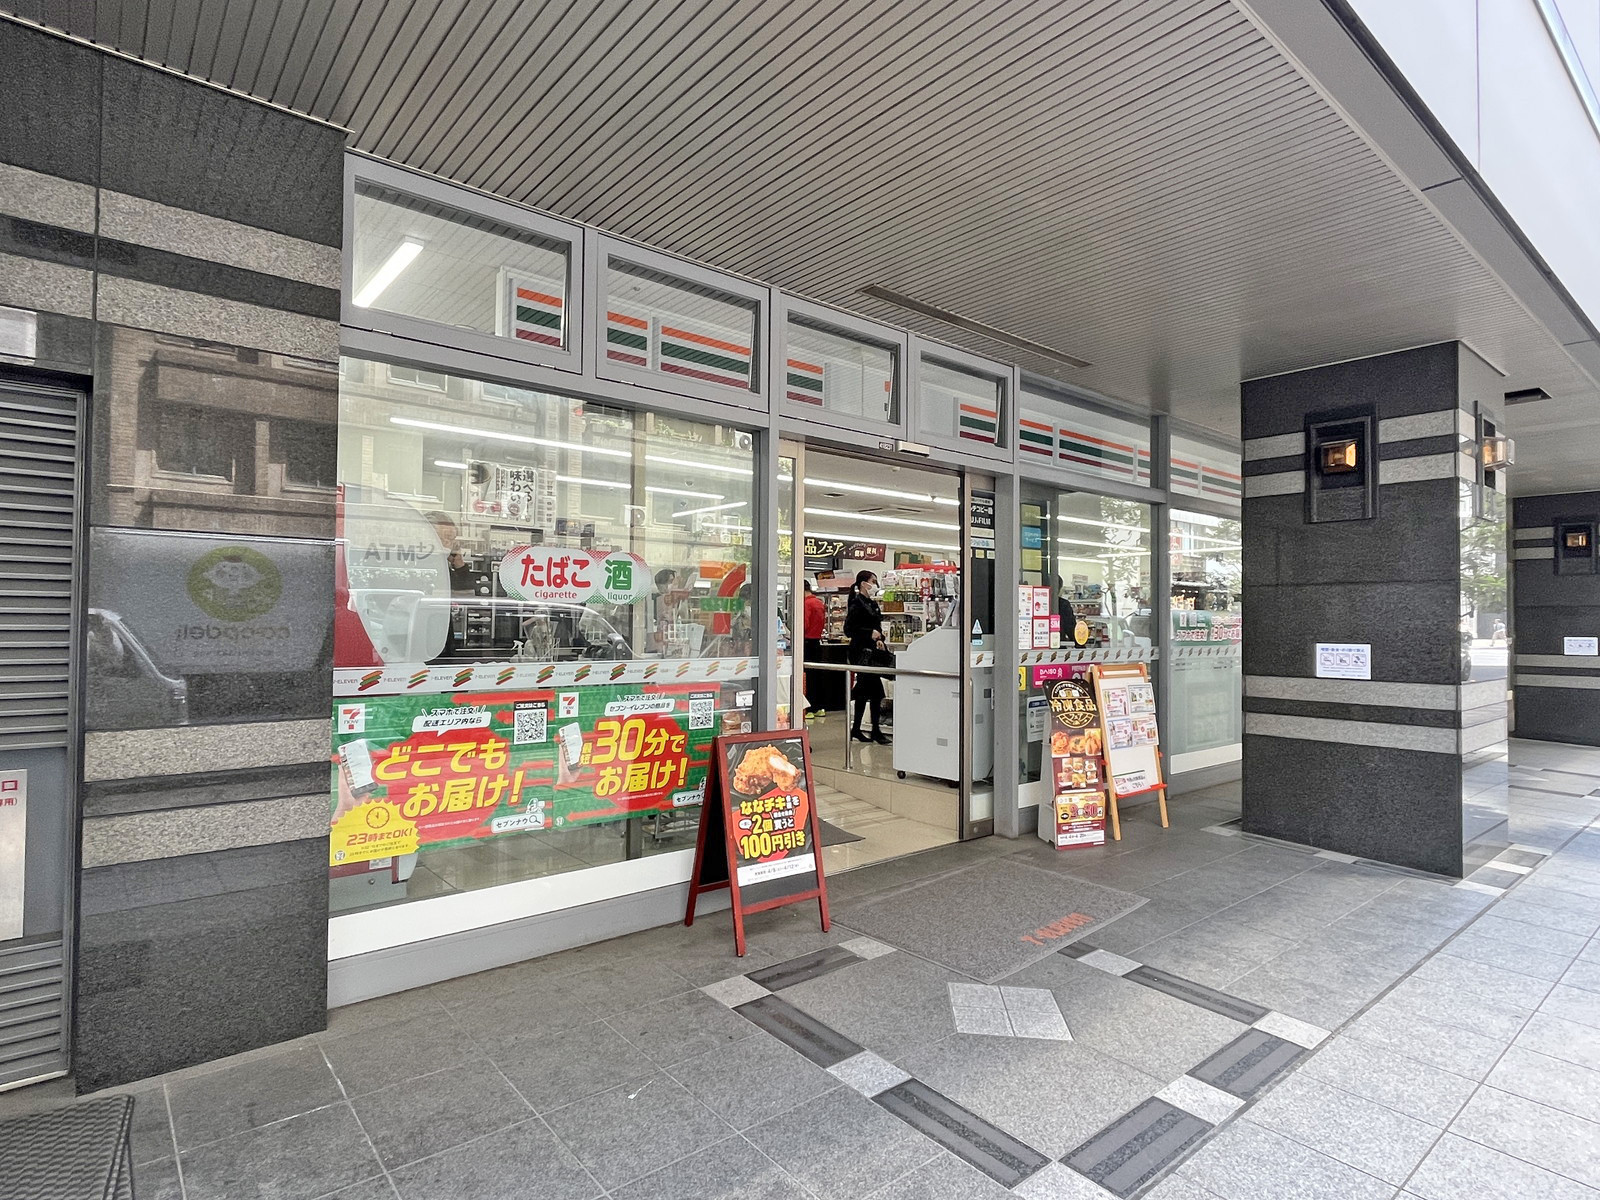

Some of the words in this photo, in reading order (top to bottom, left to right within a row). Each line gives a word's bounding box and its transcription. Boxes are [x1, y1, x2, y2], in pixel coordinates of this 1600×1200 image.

[364, 543, 415, 561] ATM
[520, 553, 591, 588] たばこ
[604, 559, 633, 590] 酒
[534, 590, 577, 599] cigarette
[607, 592, 633, 601] liquor
[431, 706, 480, 717] スマホで注文!
[592, 719, 686, 764] 30分で
[375, 738, 509, 781] どこでも
[2, 780, 17, 792] 口
[595, 757, 688, 797] お届け!
[402, 770, 524, 818] お届け!
[676, 793, 701, 803] セブンナウ
[495, 818, 528, 829] セブンナウ
[752, 814, 795, 834] 2個買うと
[346, 827, 413, 846] 23時までOK!
[740, 830, 805, 859] 100円引き
